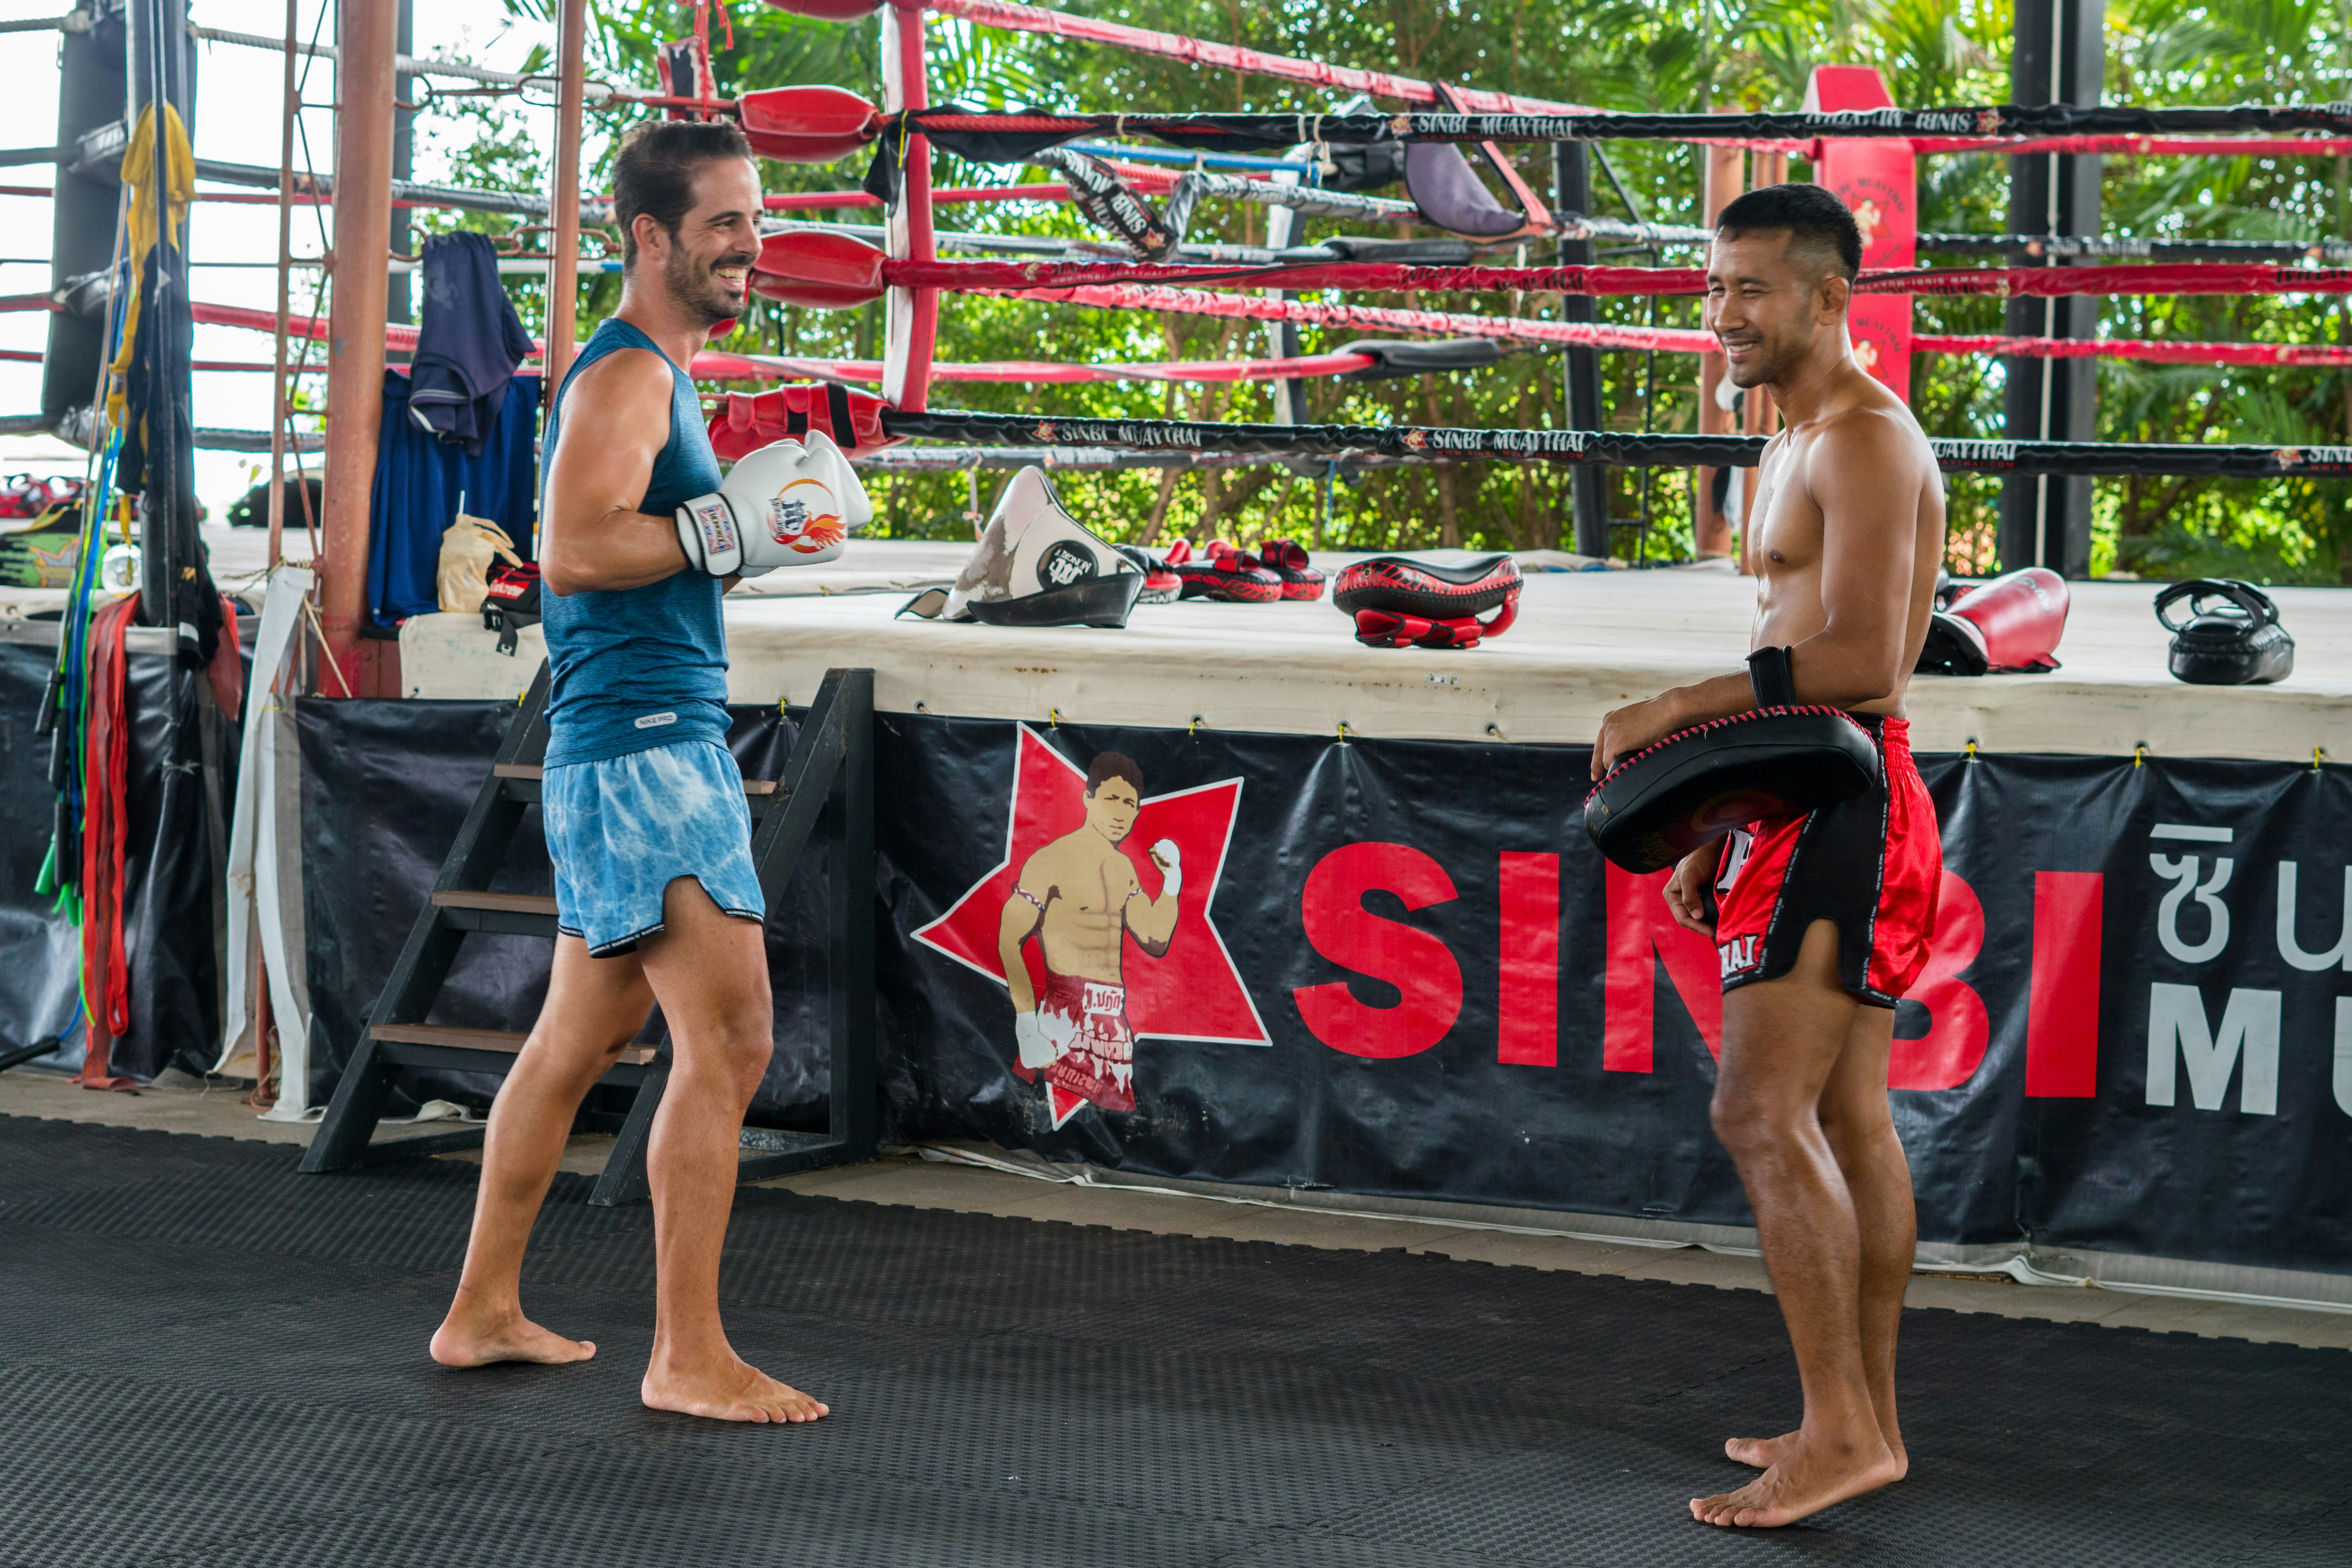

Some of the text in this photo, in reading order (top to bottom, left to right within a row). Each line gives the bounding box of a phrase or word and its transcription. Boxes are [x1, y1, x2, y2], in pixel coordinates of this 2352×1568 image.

[1418, 115, 1573, 138] SINBI MUAYTHAI
[1061, 422, 1108, 441] SINBI
[1118, 423, 1201, 447] MUAYTHAI
[1433, 429, 1585, 452] SINBI MUAYTHAI
[1930, 442, 2018, 461] UAYTHAI
[1790, 848, 1799, 866] THAILAND
